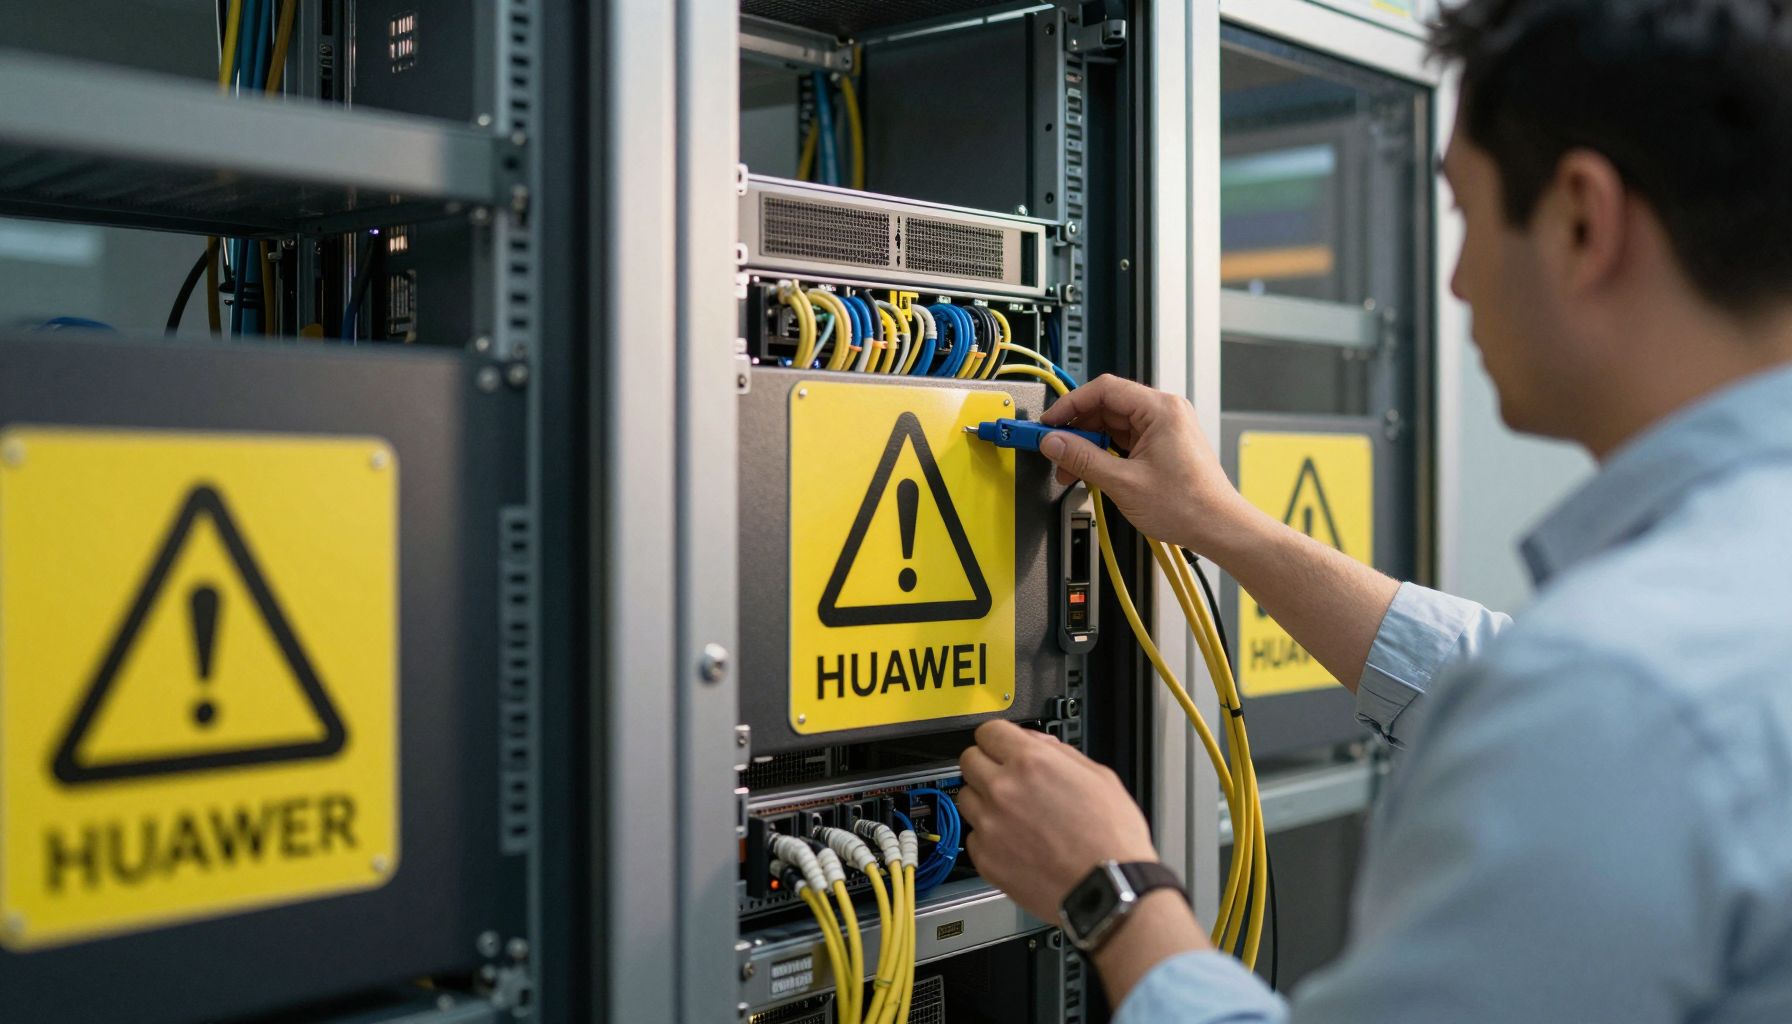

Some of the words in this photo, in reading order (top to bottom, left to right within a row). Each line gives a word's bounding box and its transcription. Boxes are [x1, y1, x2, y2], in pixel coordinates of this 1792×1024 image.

[817, 642, 987, 700] HUAWEI
[1250, 637, 1311, 672] HUA
[44, 794, 359, 891] HUAWER
